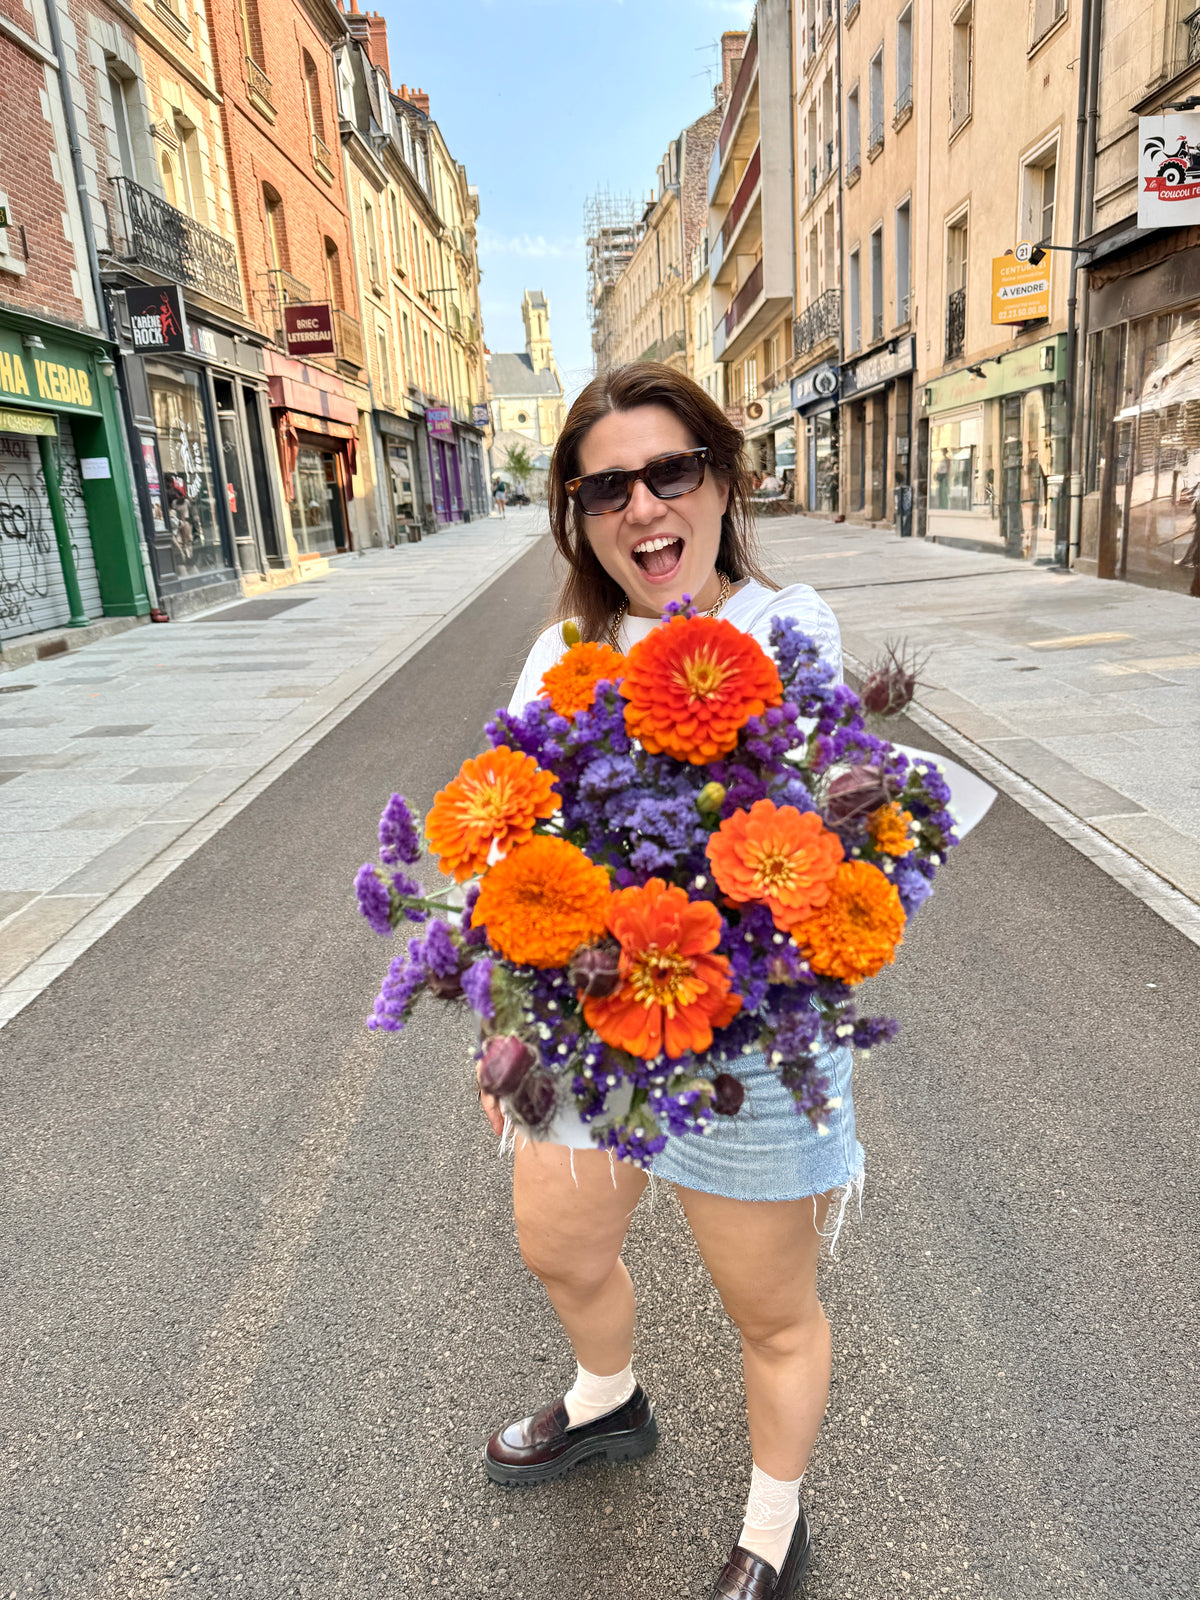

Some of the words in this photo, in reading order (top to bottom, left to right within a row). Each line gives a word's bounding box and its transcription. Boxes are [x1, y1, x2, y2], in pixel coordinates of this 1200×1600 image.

[1160, 188, 1190, 198] coucou
[1020, 247, 1029, 257] 21
[1002, 287, 1008, 298] À
[1010, 283, 1044, 296] VENDRE
[296, 318, 319, 329] BRIEC
[133, 328, 164, 345] ROCK
[287, 331, 331, 343] LETERREAU
[0, 350, 30, 396] HA
[34, 359, 92, 407] KEBAB
